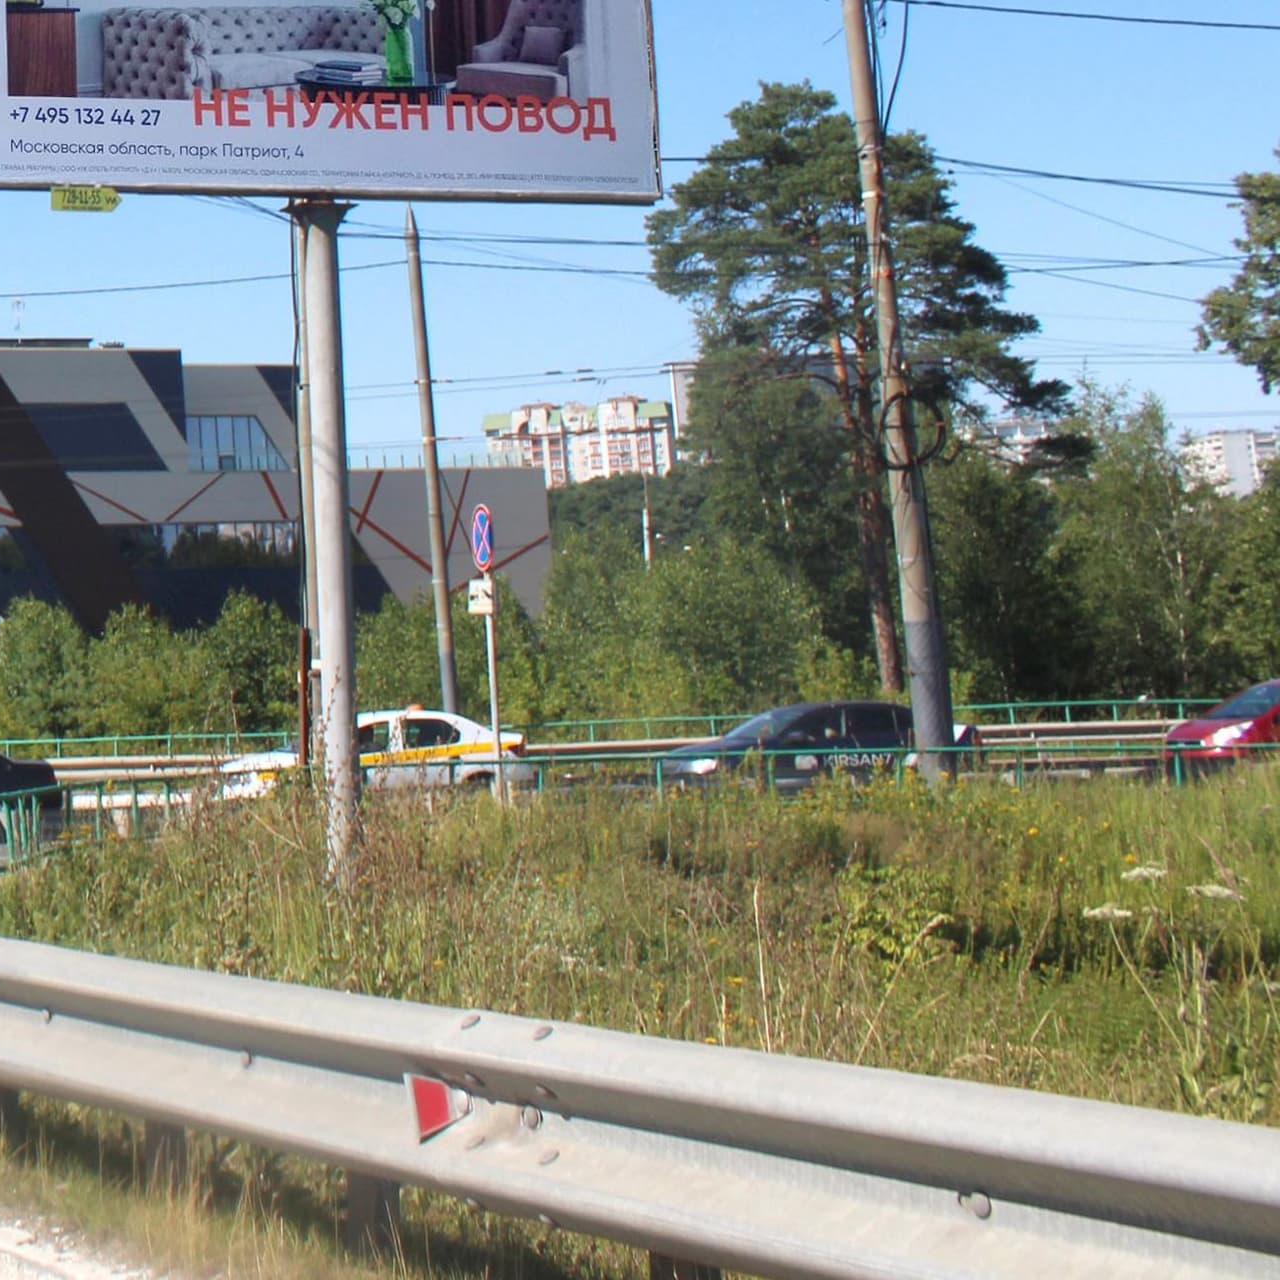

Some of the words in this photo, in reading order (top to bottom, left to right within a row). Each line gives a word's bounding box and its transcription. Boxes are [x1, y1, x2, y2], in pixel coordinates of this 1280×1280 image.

[9, 106, 29, 123] +7
[34, 107, 70, 124] 495
[74, 108, 105, 125] 132
[110, 108, 136, 126] 44
[141, 109, 161, 126] 27
[192, 88, 251, 128] НЕ
[265, 89, 430, 131] НУЖЕН
[445, 94, 617, 142] ПОВОД
[10, 138, 105, 155] Московская
[108, 140, 175, 158] область,
[179, 144, 218, 159] парк
[222, 143, 291, 161] Патриот,
[294, 144, 305, 159] 4
